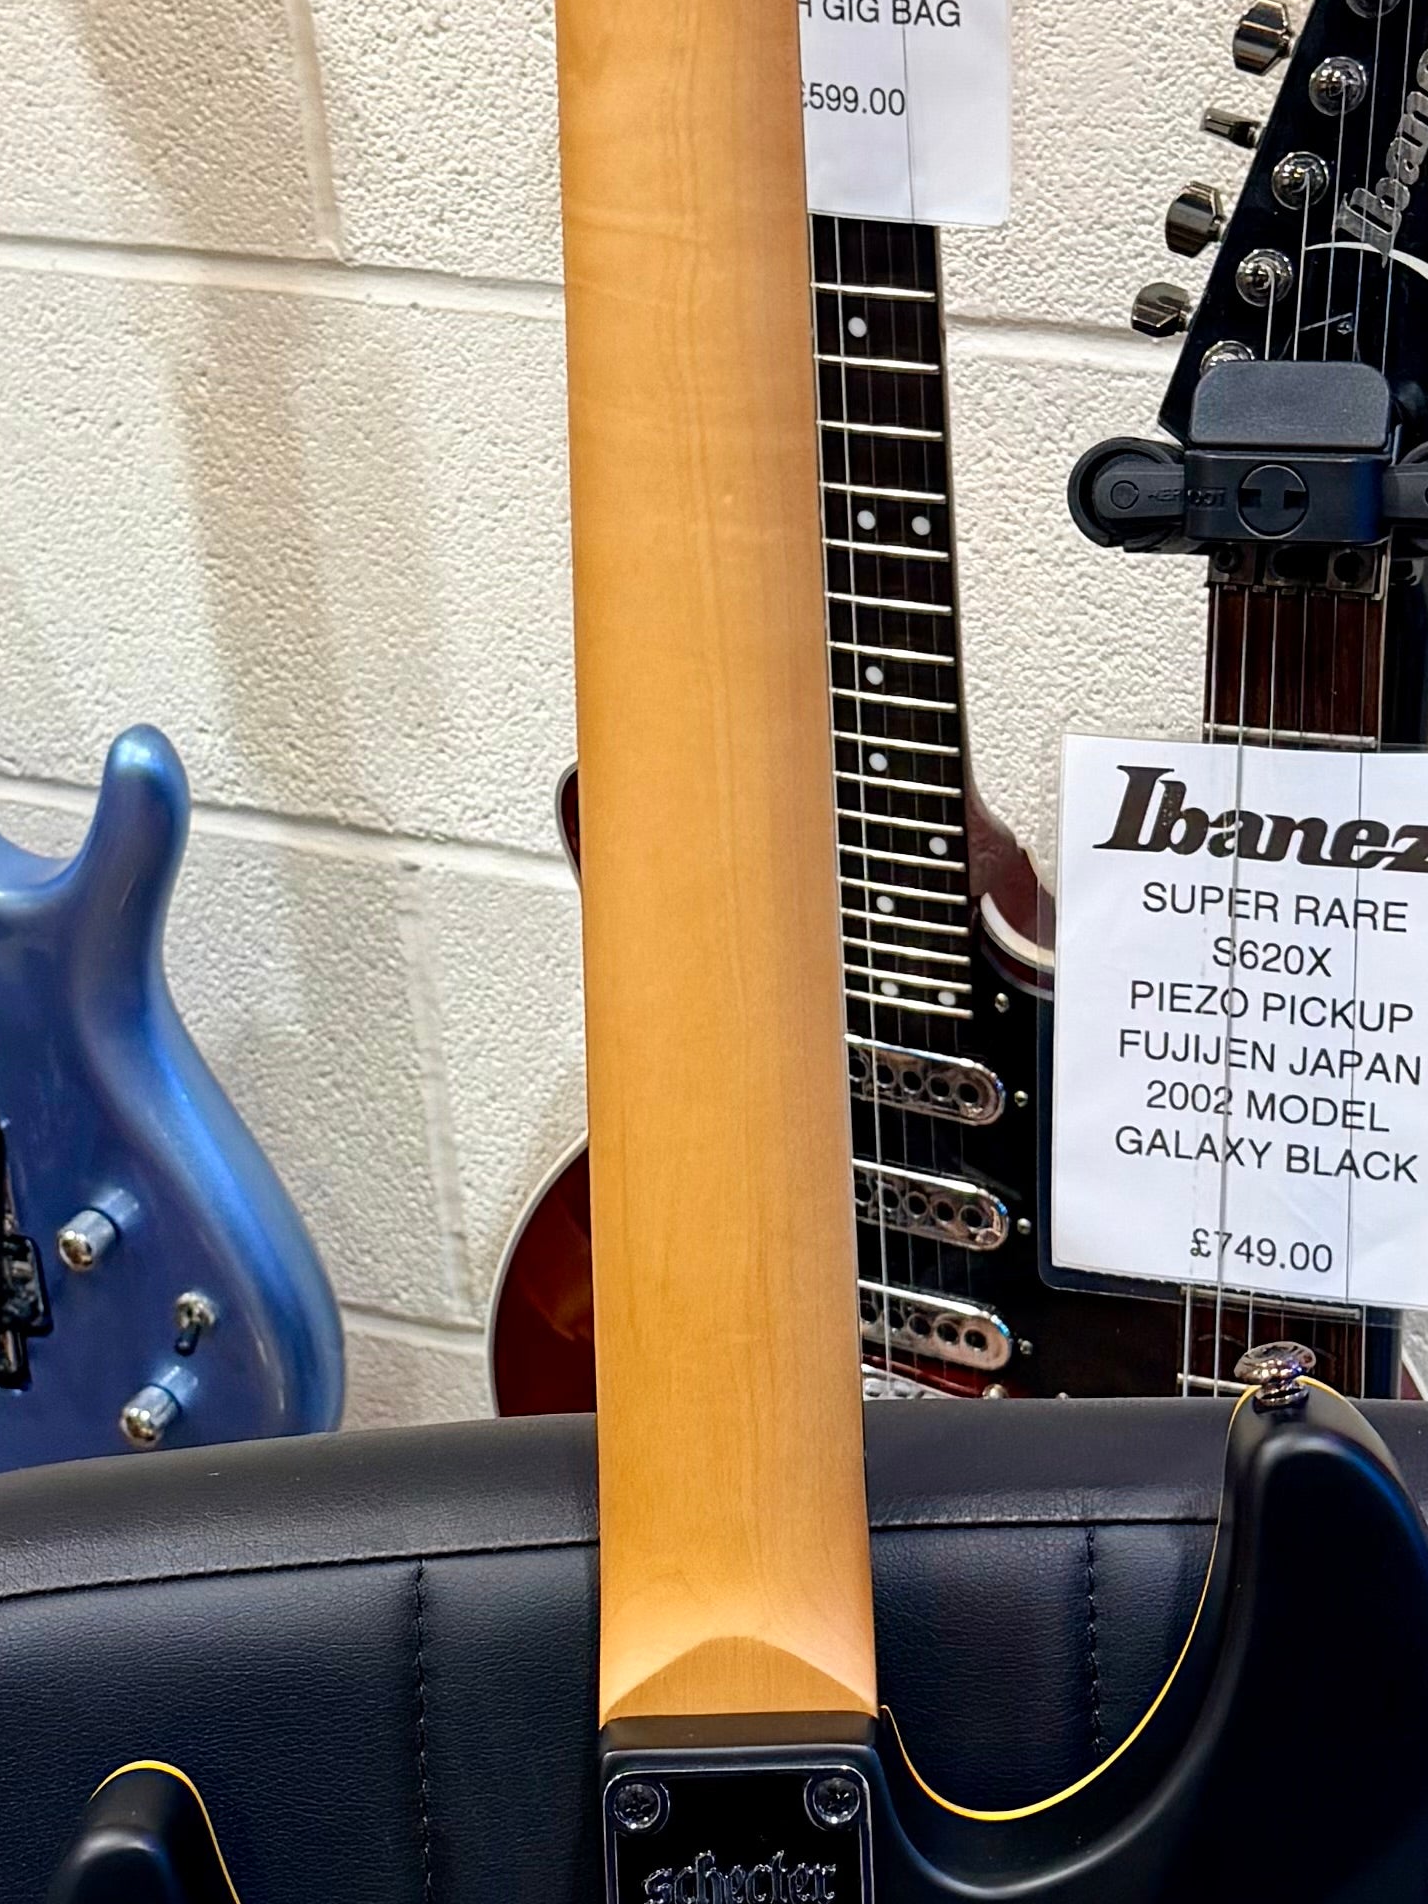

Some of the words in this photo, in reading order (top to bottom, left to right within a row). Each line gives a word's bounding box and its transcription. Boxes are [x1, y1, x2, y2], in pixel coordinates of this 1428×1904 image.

[802, 82, 906, 117] 599.00
[1141, 881, 1279, 924] SUPER
[1294, 894, 1409, 934] RARE
[1212, 937, 1333, 978] S620X
[1130, 980, 1249, 1019] PIEZO
[1262, 991, 1413, 1034] PICKUP
[1119, 1028, 1275, 1074] FUJIJEN
[1289, 1046, 1421, 1087] JAPAN
[1146, 1080, 1233, 1115] 2002
[1247, 1090, 1390, 1134] MODEL
[1115, 1126, 1273, 1170] GALAXY
[1286, 1144, 1419, 1184] BLACK
[1190, 1227, 1334, 1274] £749.00
